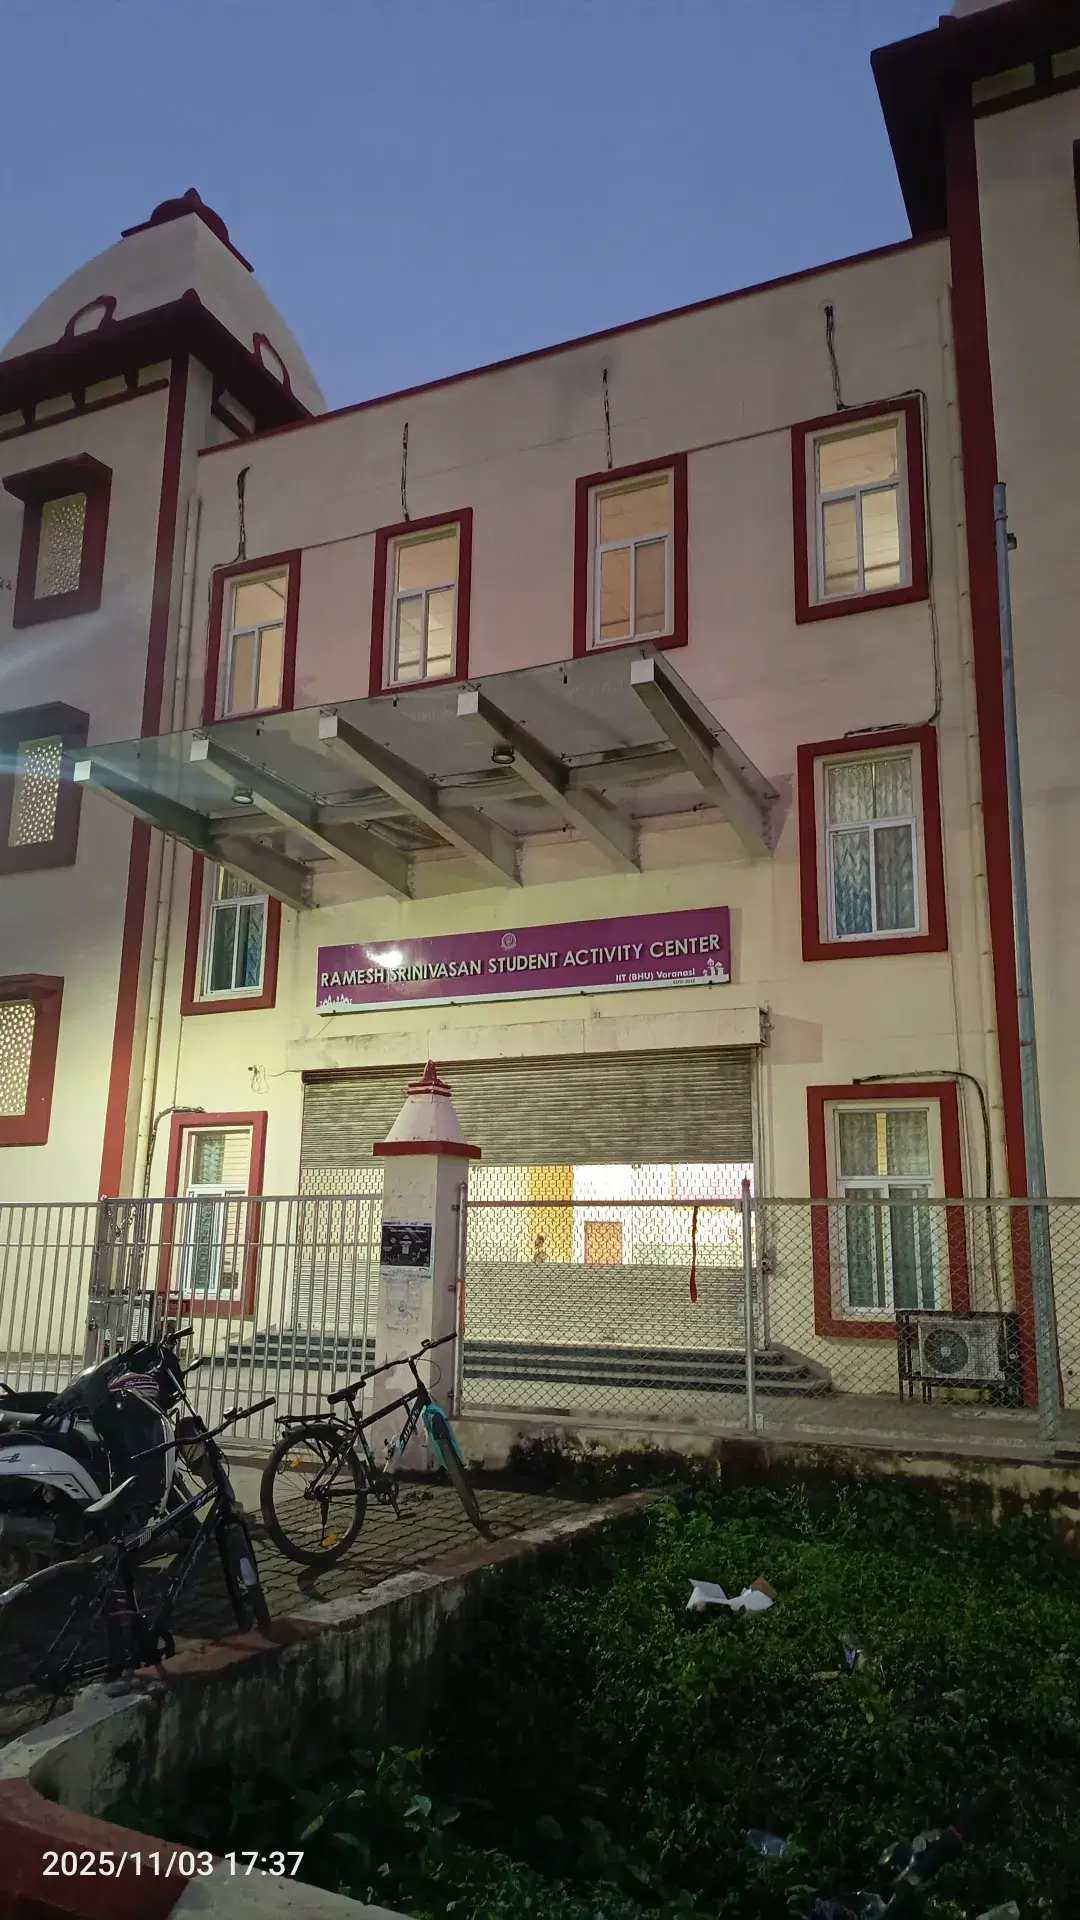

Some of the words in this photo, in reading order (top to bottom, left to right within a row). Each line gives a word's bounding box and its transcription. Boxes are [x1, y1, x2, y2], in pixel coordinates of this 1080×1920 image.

[320, 969, 384, 988] RAMESH
[389, 959, 482, 981] SRINIVASAN
[488, 953, 558, 974] STUDENT
[562, 944, 643, 967] ACTIVITY
[649, 934, 720, 958] CENTER
[615, 974, 627, 982] IIT
[628, 971, 654, 982] (BHU)
[656, 967, 696, 979] Varanasi
